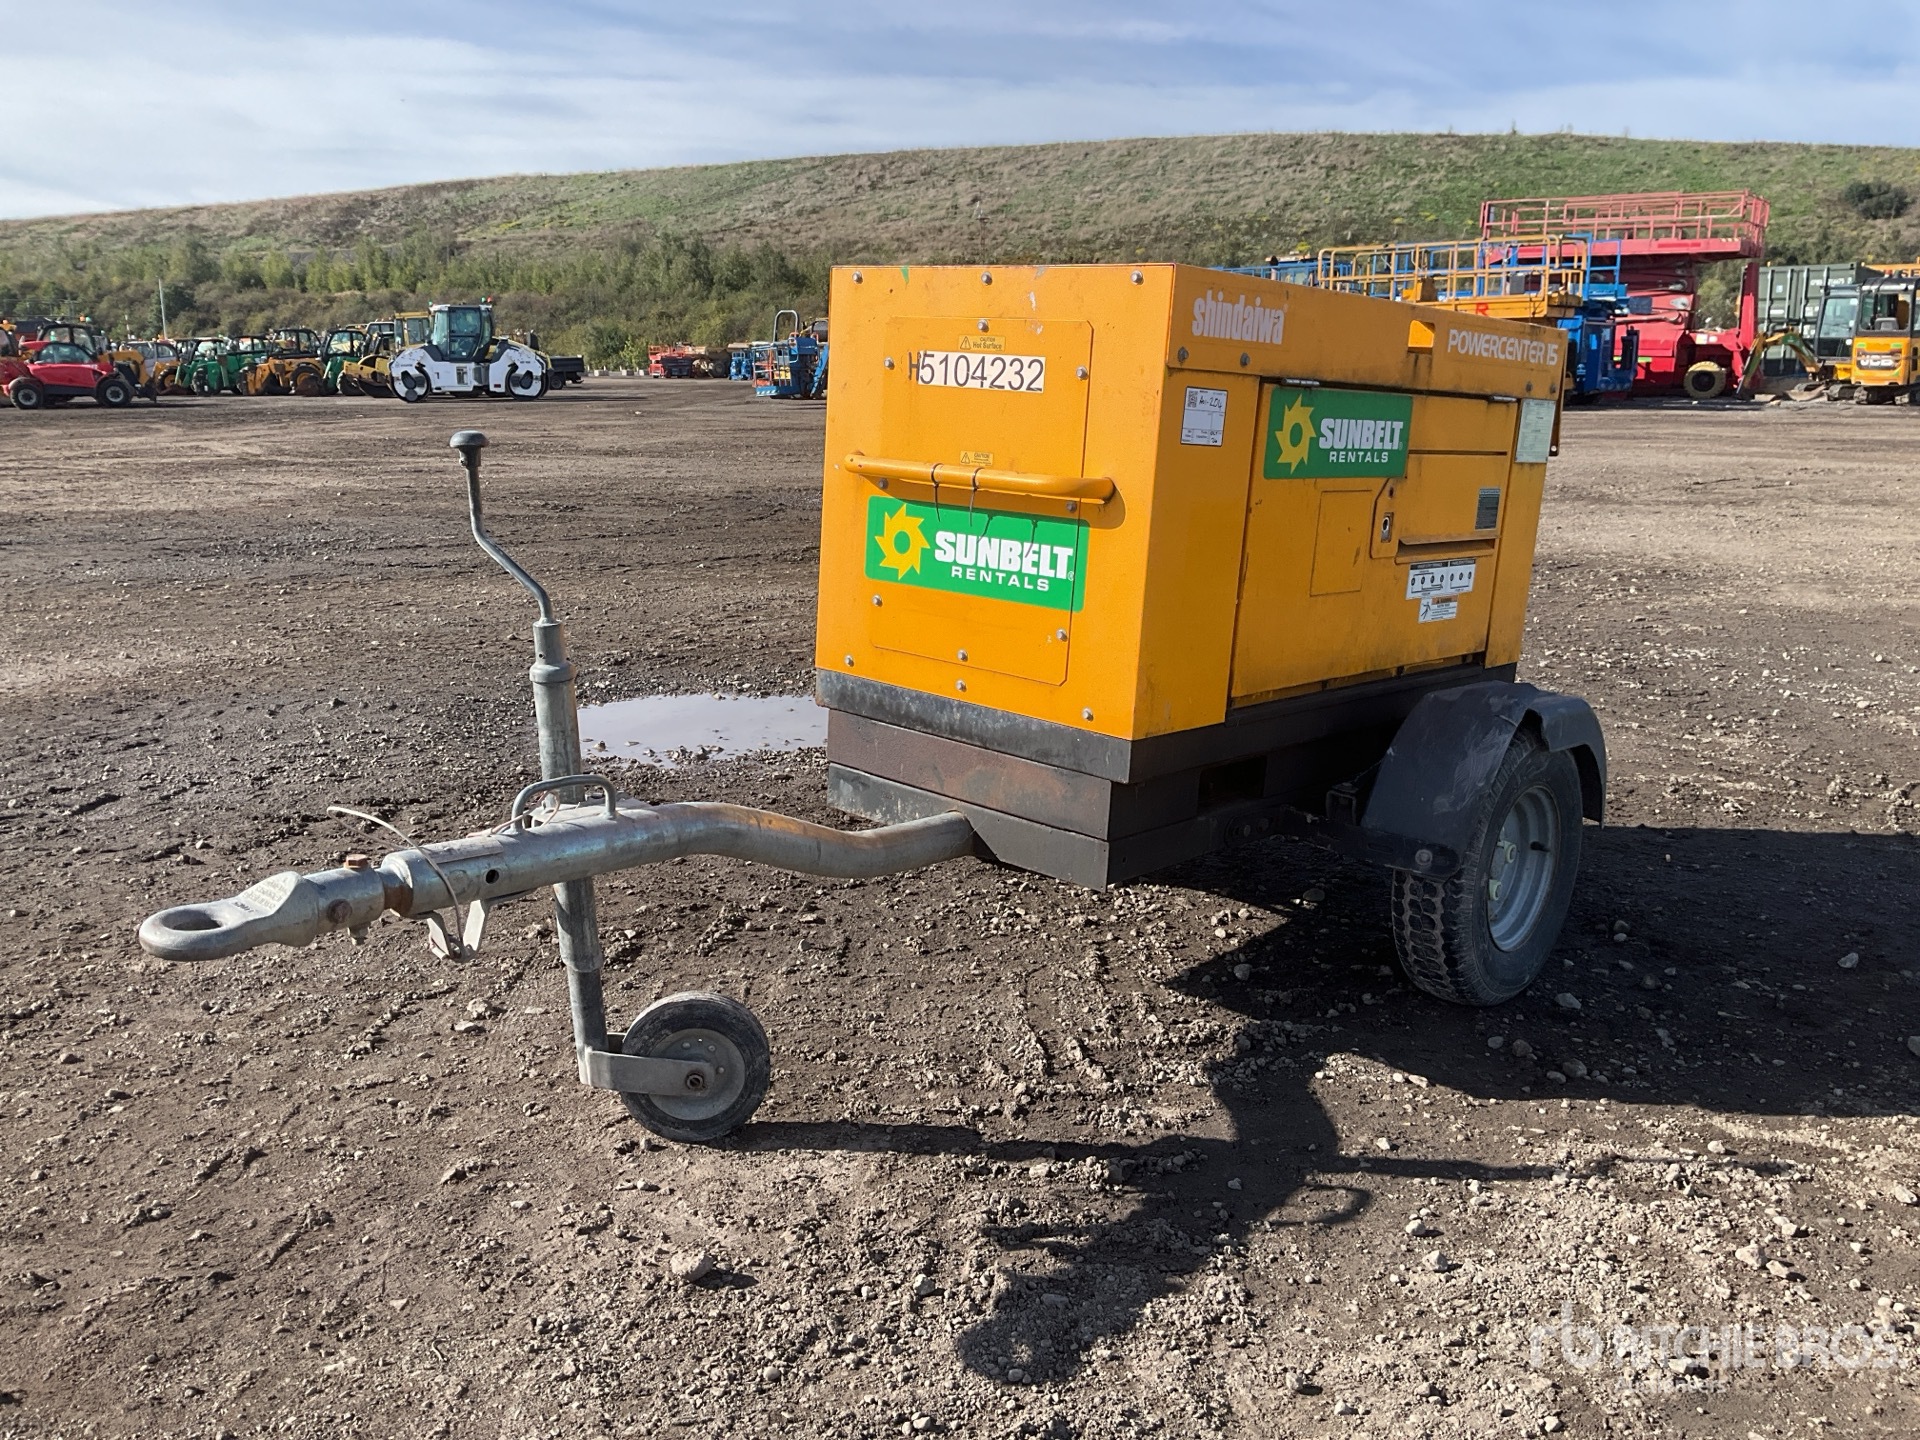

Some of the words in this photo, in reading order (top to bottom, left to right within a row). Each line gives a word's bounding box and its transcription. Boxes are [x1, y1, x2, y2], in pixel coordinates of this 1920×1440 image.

[1192, 290, 1284, 345] shindaiwa
[982, 341, 1003, 350] Surface
[1447, 329, 1545, 364] POWERCENTER
[1546, 343, 1558, 366] 15
[1319, 418, 1404, 450] SUNBELT
[1329, 451, 1389, 463] RENTALS
[934, 530, 1074, 580] SUNBELT
[951, 565, 1050, 592] RENTALS
